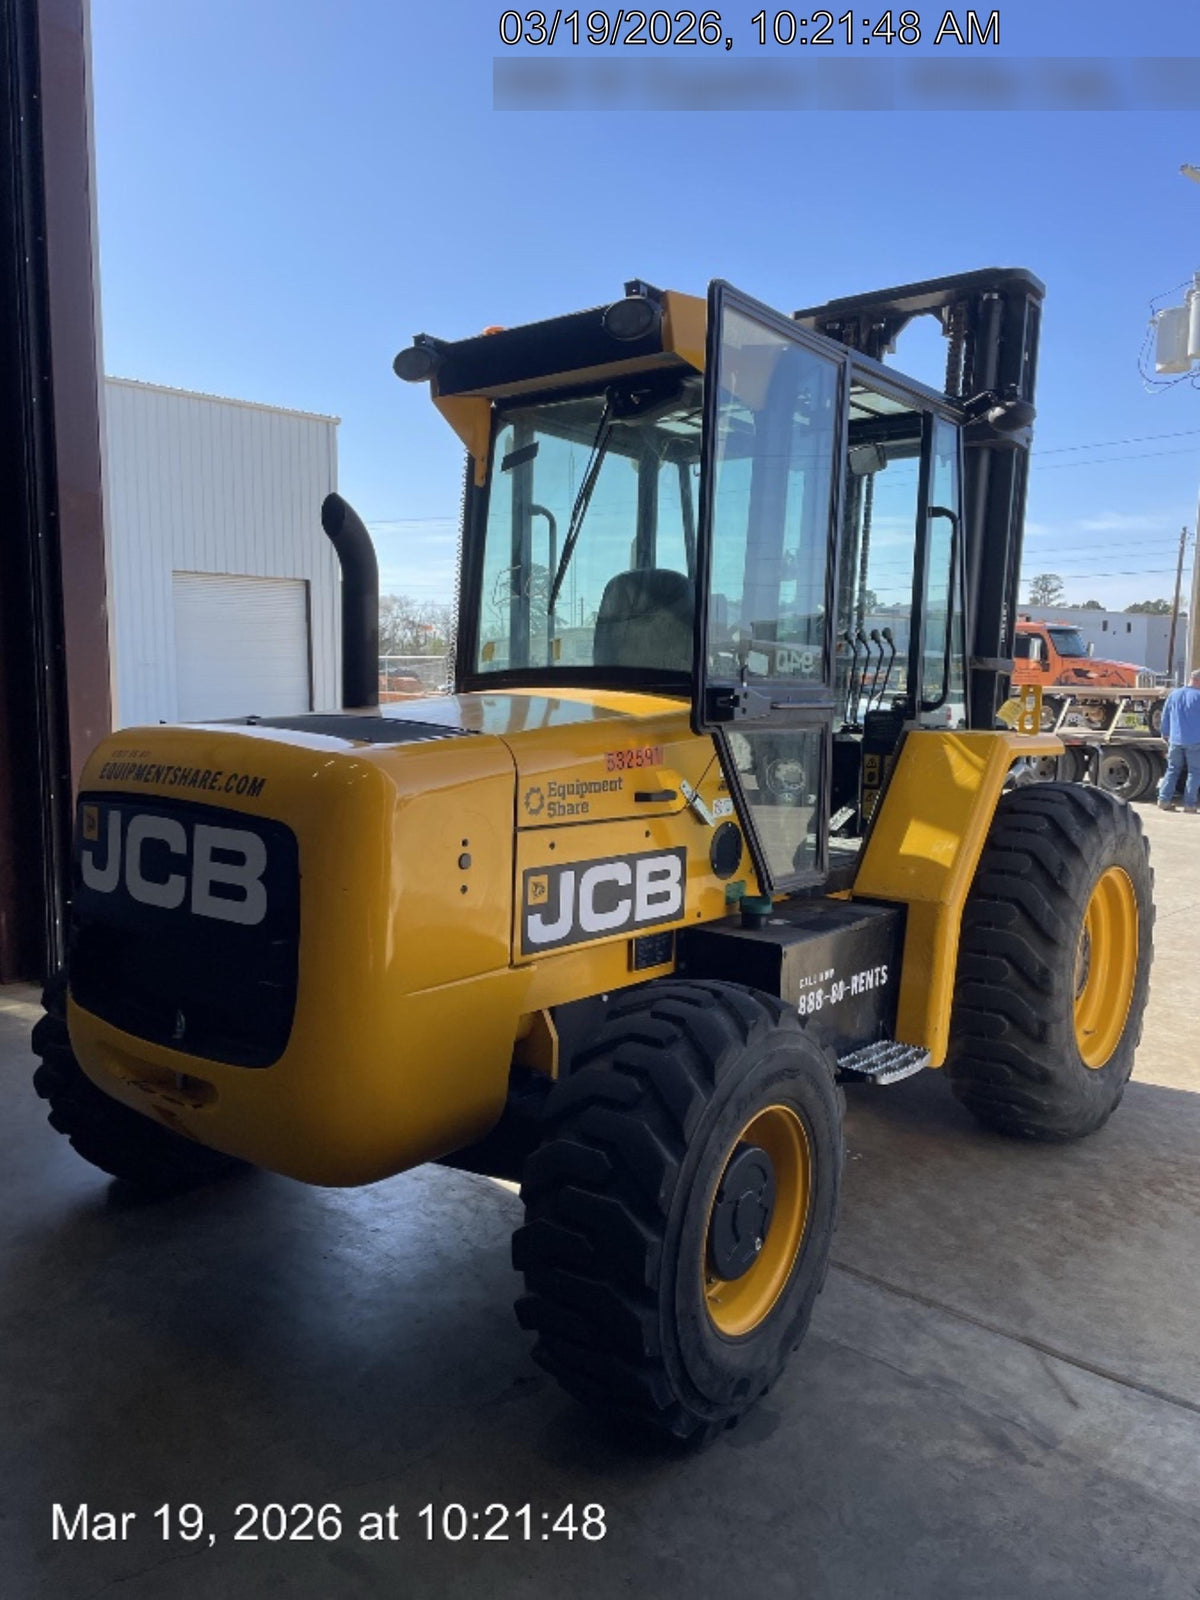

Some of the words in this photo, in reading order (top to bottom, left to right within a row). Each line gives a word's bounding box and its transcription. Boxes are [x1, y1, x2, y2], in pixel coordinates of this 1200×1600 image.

[99, 762, 266, 797] EQUIPMENTSHARE.COM
[547, 777, 623, 800] Equipment
[547, 801, 589, 818] Share
[81, 810, 268, 926] JCB
[527, 854, 682, 945] JCB
